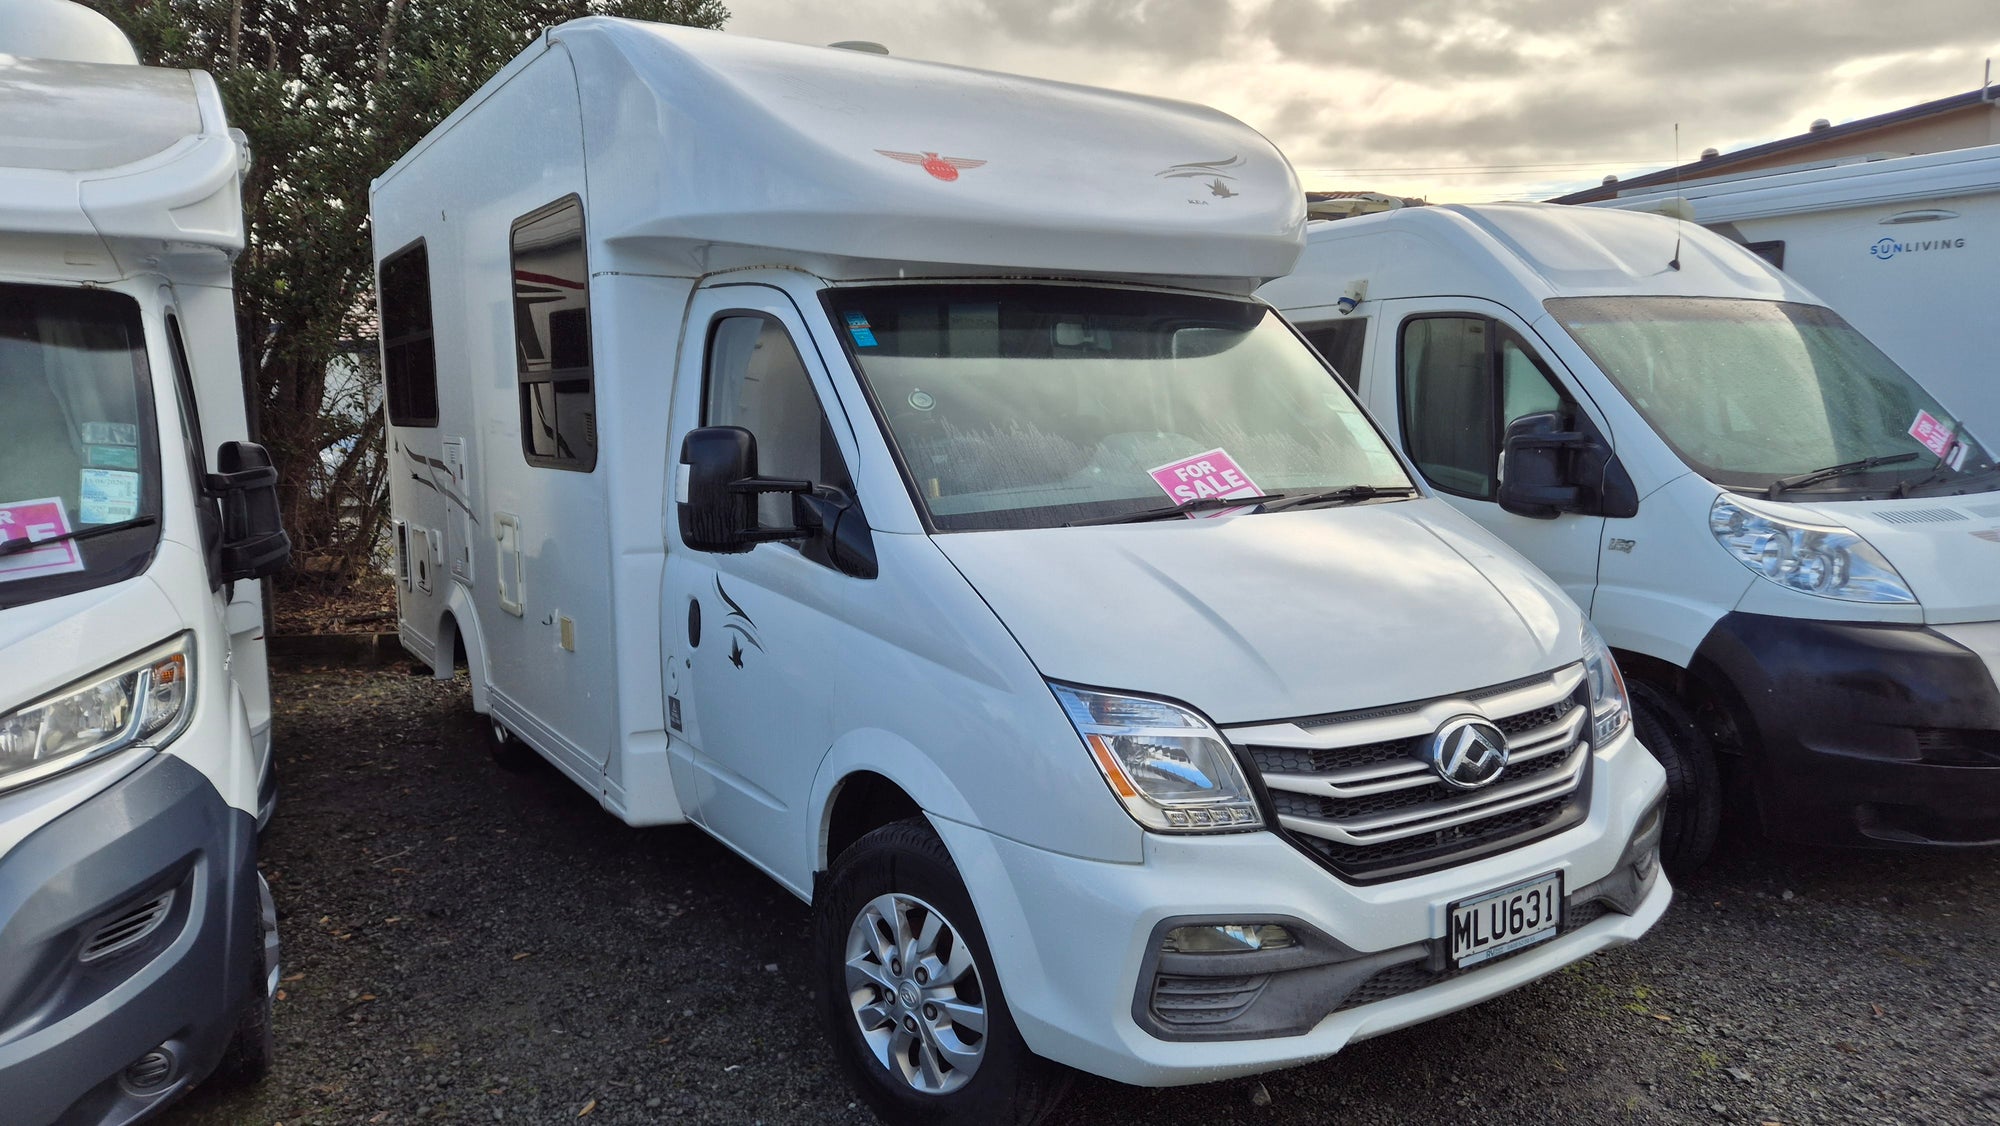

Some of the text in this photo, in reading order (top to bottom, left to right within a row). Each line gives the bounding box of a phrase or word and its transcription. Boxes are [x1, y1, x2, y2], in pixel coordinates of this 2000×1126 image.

[1870, 238, 1965, 255] SUNLIVING
[1174, 460, 1216, 482] FOR
[1174, 468, 1246, 503] SALE
[1454, 885, 1553, 954] MLU631
